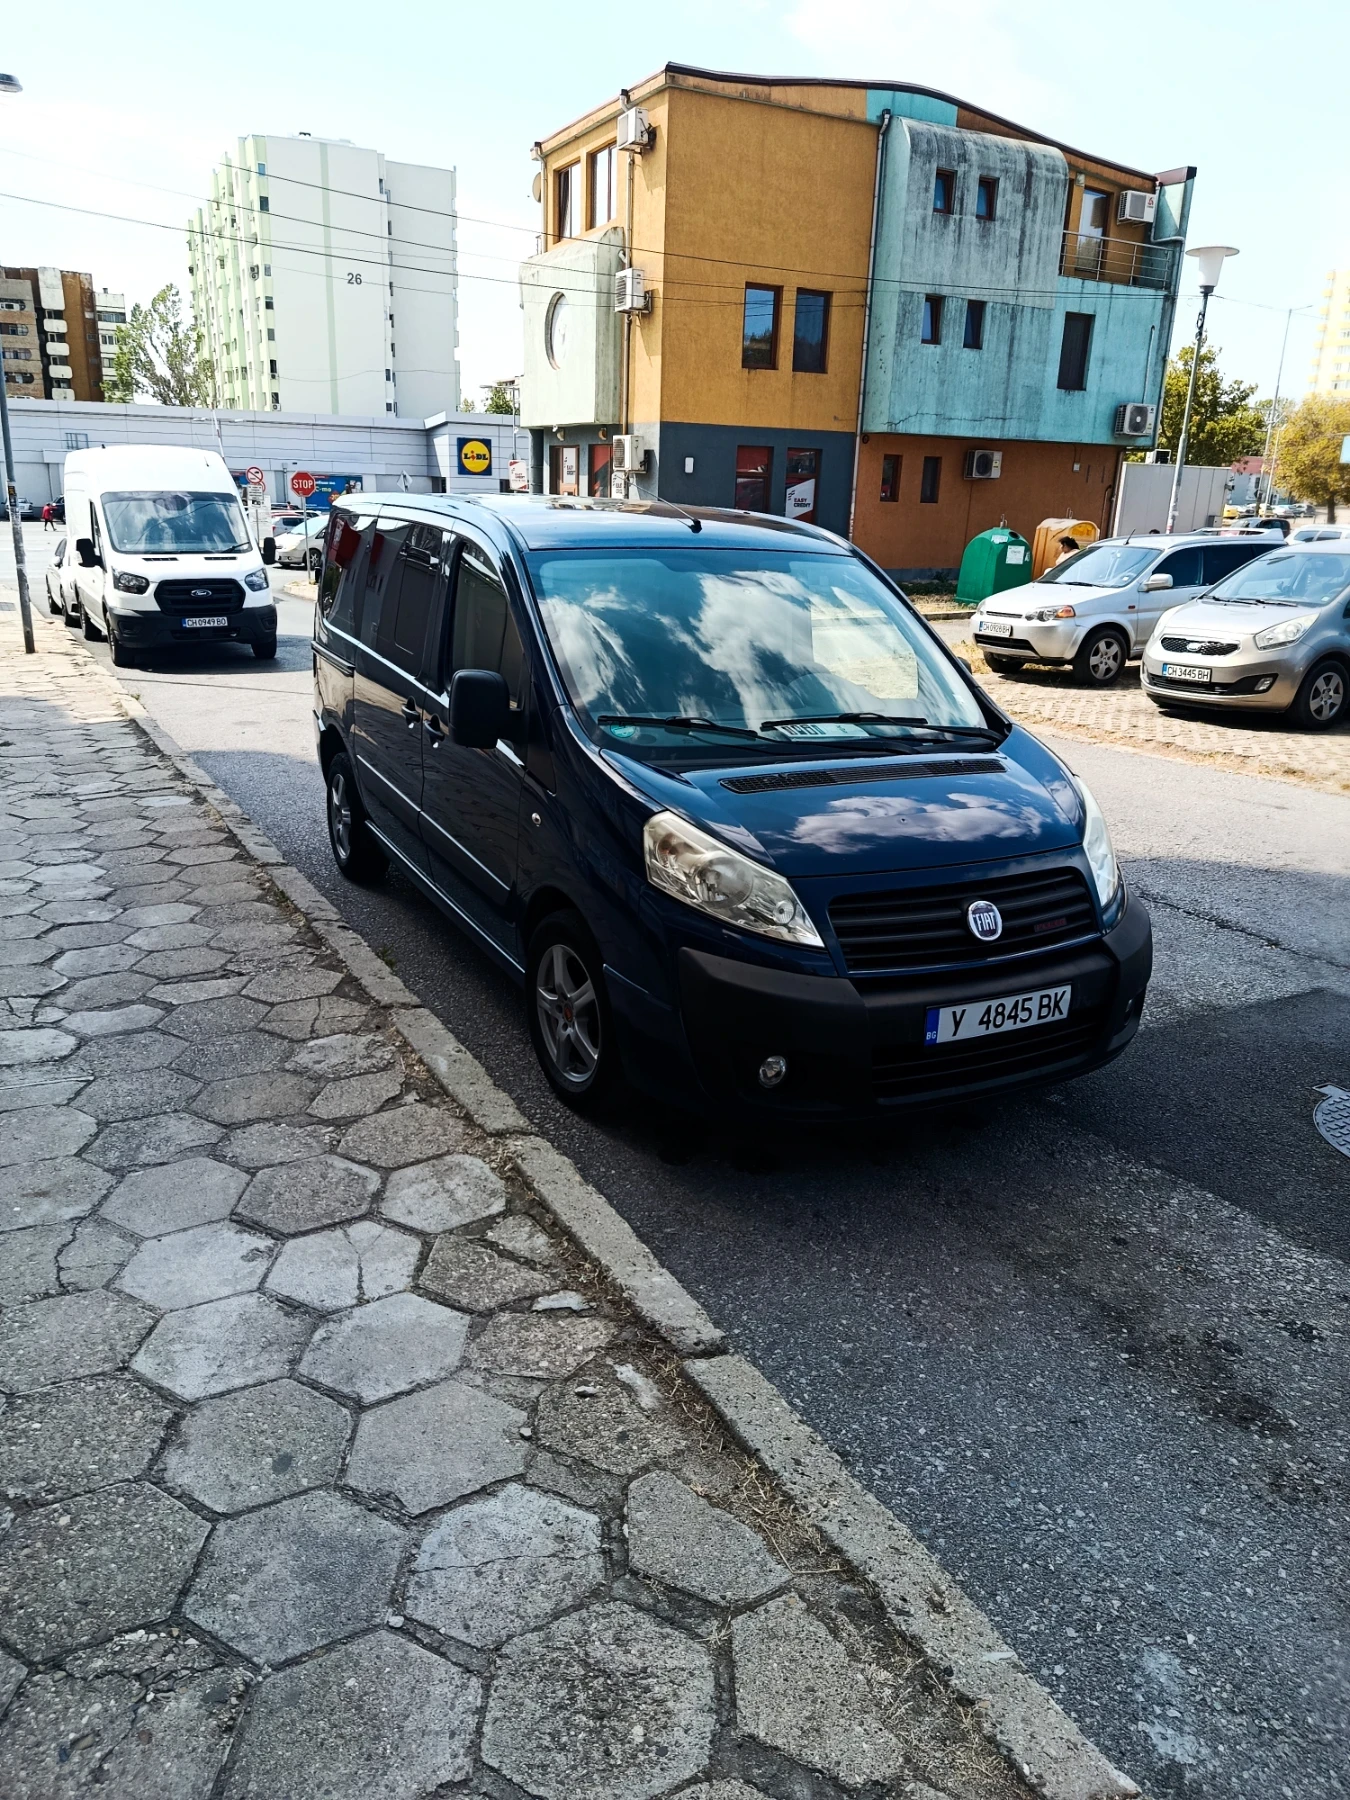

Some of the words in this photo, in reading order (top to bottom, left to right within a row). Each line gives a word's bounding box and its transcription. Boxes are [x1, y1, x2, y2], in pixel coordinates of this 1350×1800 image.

[347, 272, 362, 285] 26
[293, 479, 313, 489] STOP
[1167, 666, 1178, 676] CH
[1178, 668, 1197, 679] 3445
[1197, 670, 1209, 680] BH
[975, 911, 996, 932] FIAT
[951, 1009, 967, 1037] Y
[978, 997, 1034, 1031] 4845
[1037, 990, 1067, 1021] BK
[926, 1030, 937, 1040] BG
